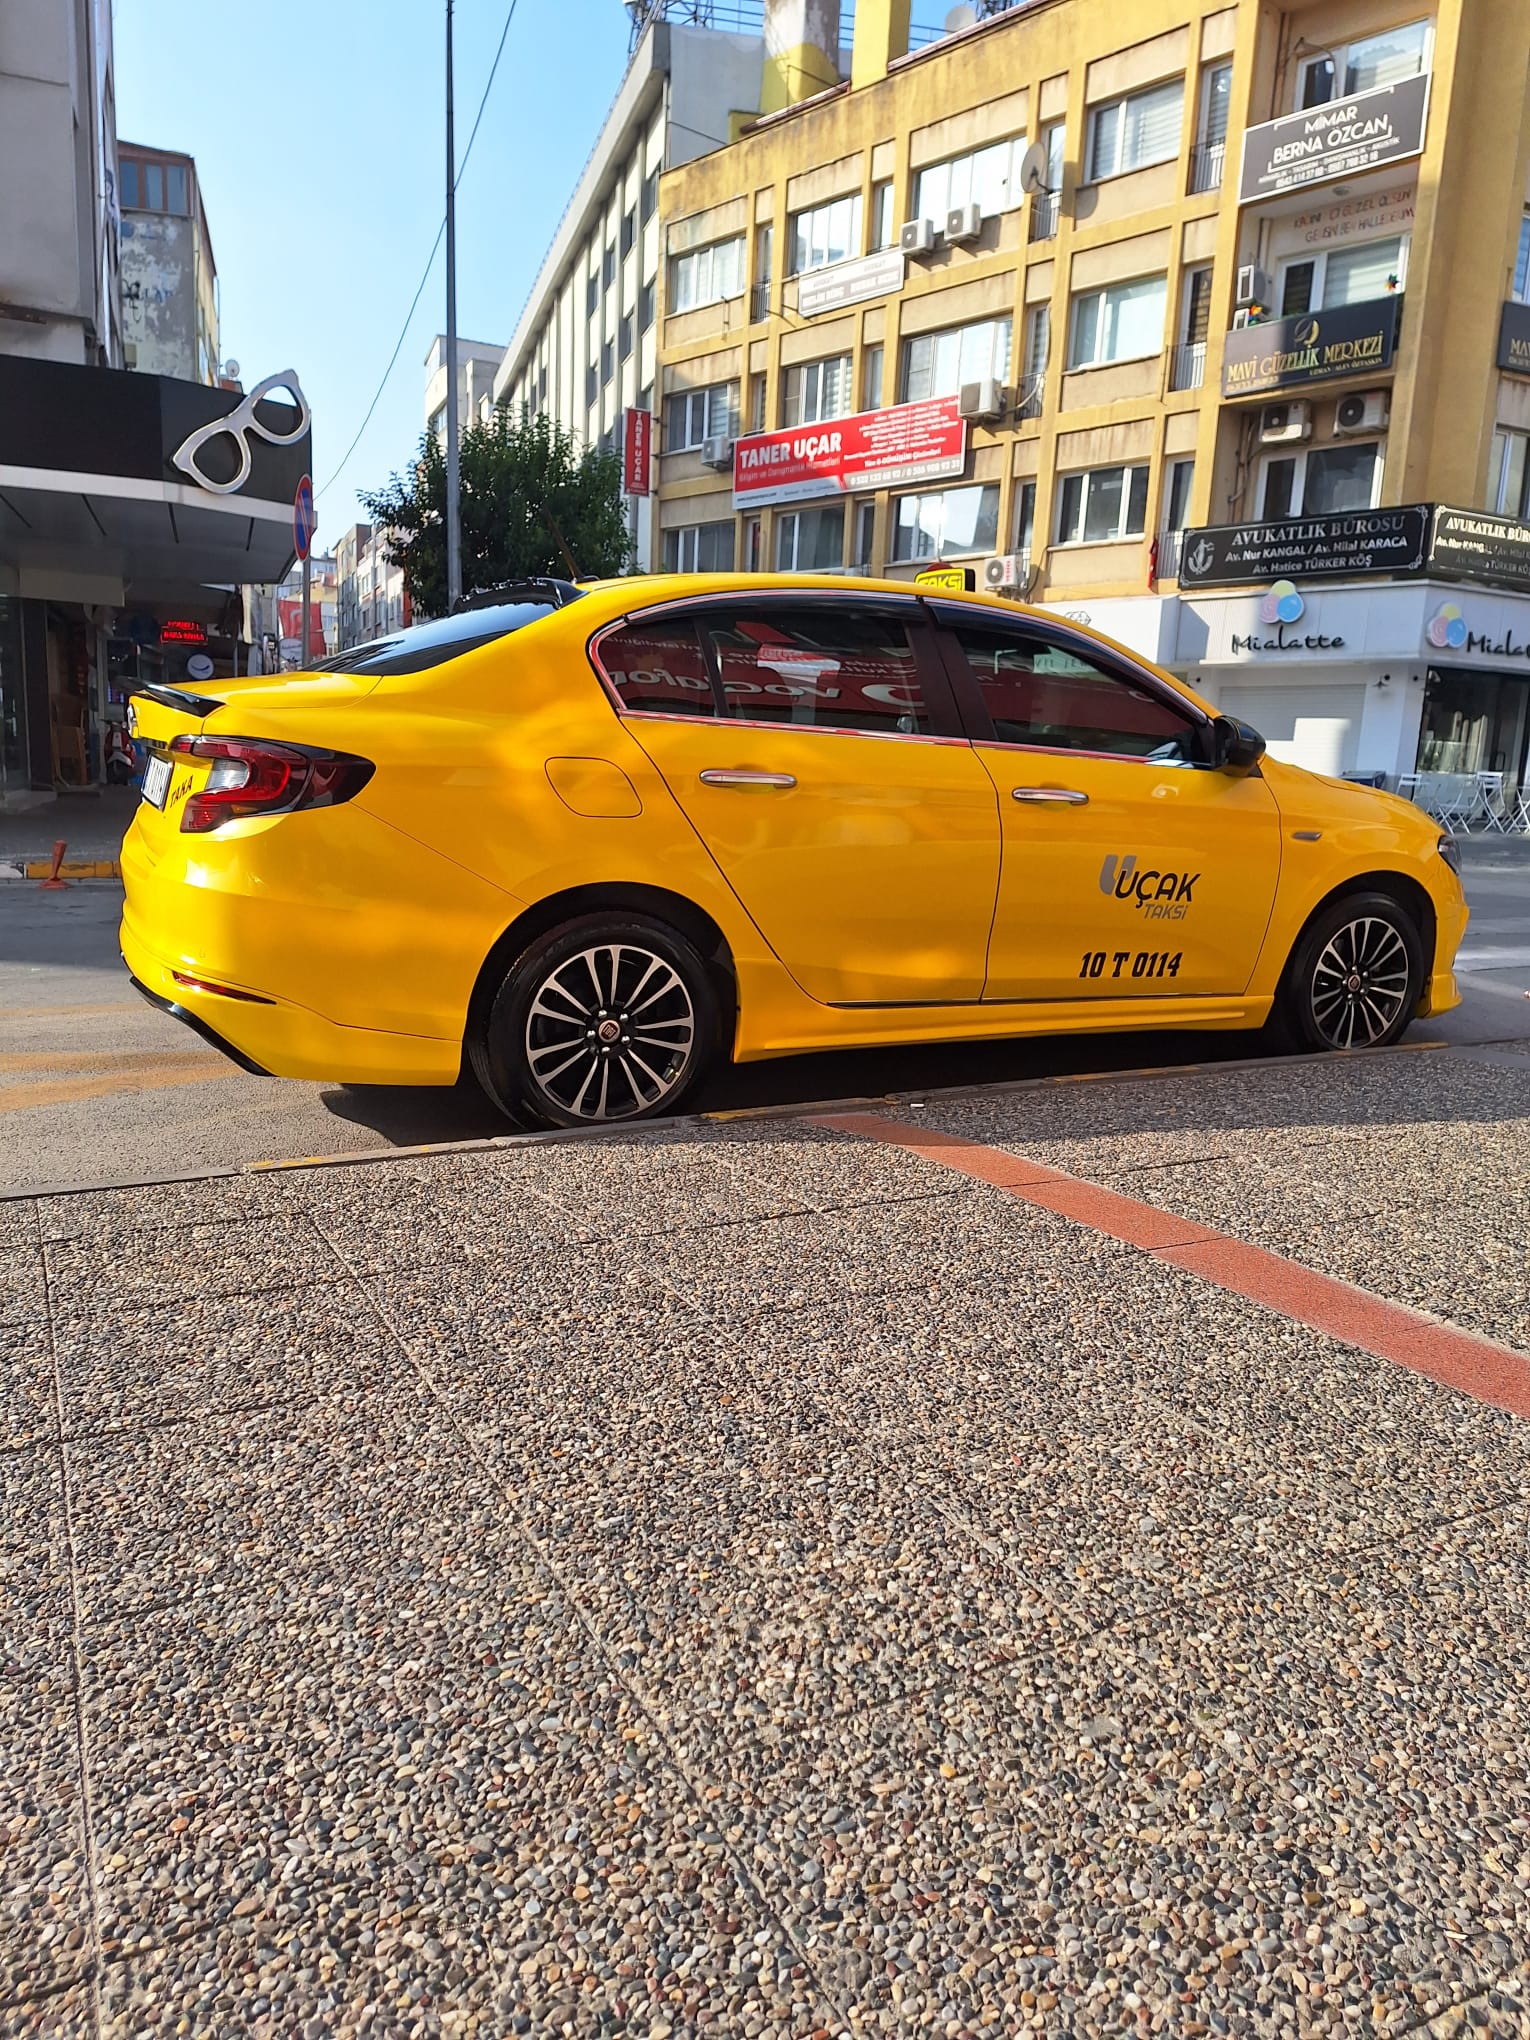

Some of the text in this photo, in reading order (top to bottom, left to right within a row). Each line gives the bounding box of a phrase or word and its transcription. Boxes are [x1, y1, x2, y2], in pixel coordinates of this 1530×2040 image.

[1304, 106, 1358, 134] MİMAR
[1273, 114, 1388, 164] BERNA ÖZCAN
[1227, 355, 1257, 383] MAVİ
[1260, 344, 1320, 376] GÜZELLİK
[1323, 330, 1384, 364] MERKEZİ
[740, 442, 791, 469] TANER
[793, 432, 842, 462] UÇAR
[1232, 515, 1406, 546] AVUKATLIK BÜROSU
[1445, 517, 1506, 539] AVUKATLIK
[1225, 550, 1241, 562] Av.
[1242, 549, 1261, 561] Nur
[1262, 545, 1306, 559] KANGAL
[1311, 543, 1328, 555] Av.
[1333, 540, 1358, 552] Hilal
[1360, 536, 1408, 550] KARACA
[1252, 554, 1373, 575] Av. Hatice TÜRKER KÖŞ
[1518, 563, 1530, 575] KÖ
[1231, 626, 1346, 654] Mialatte
[1115, 870, 1201, 908] UÇAK
[1079, 952, 1183, 978] 10 T 0114
